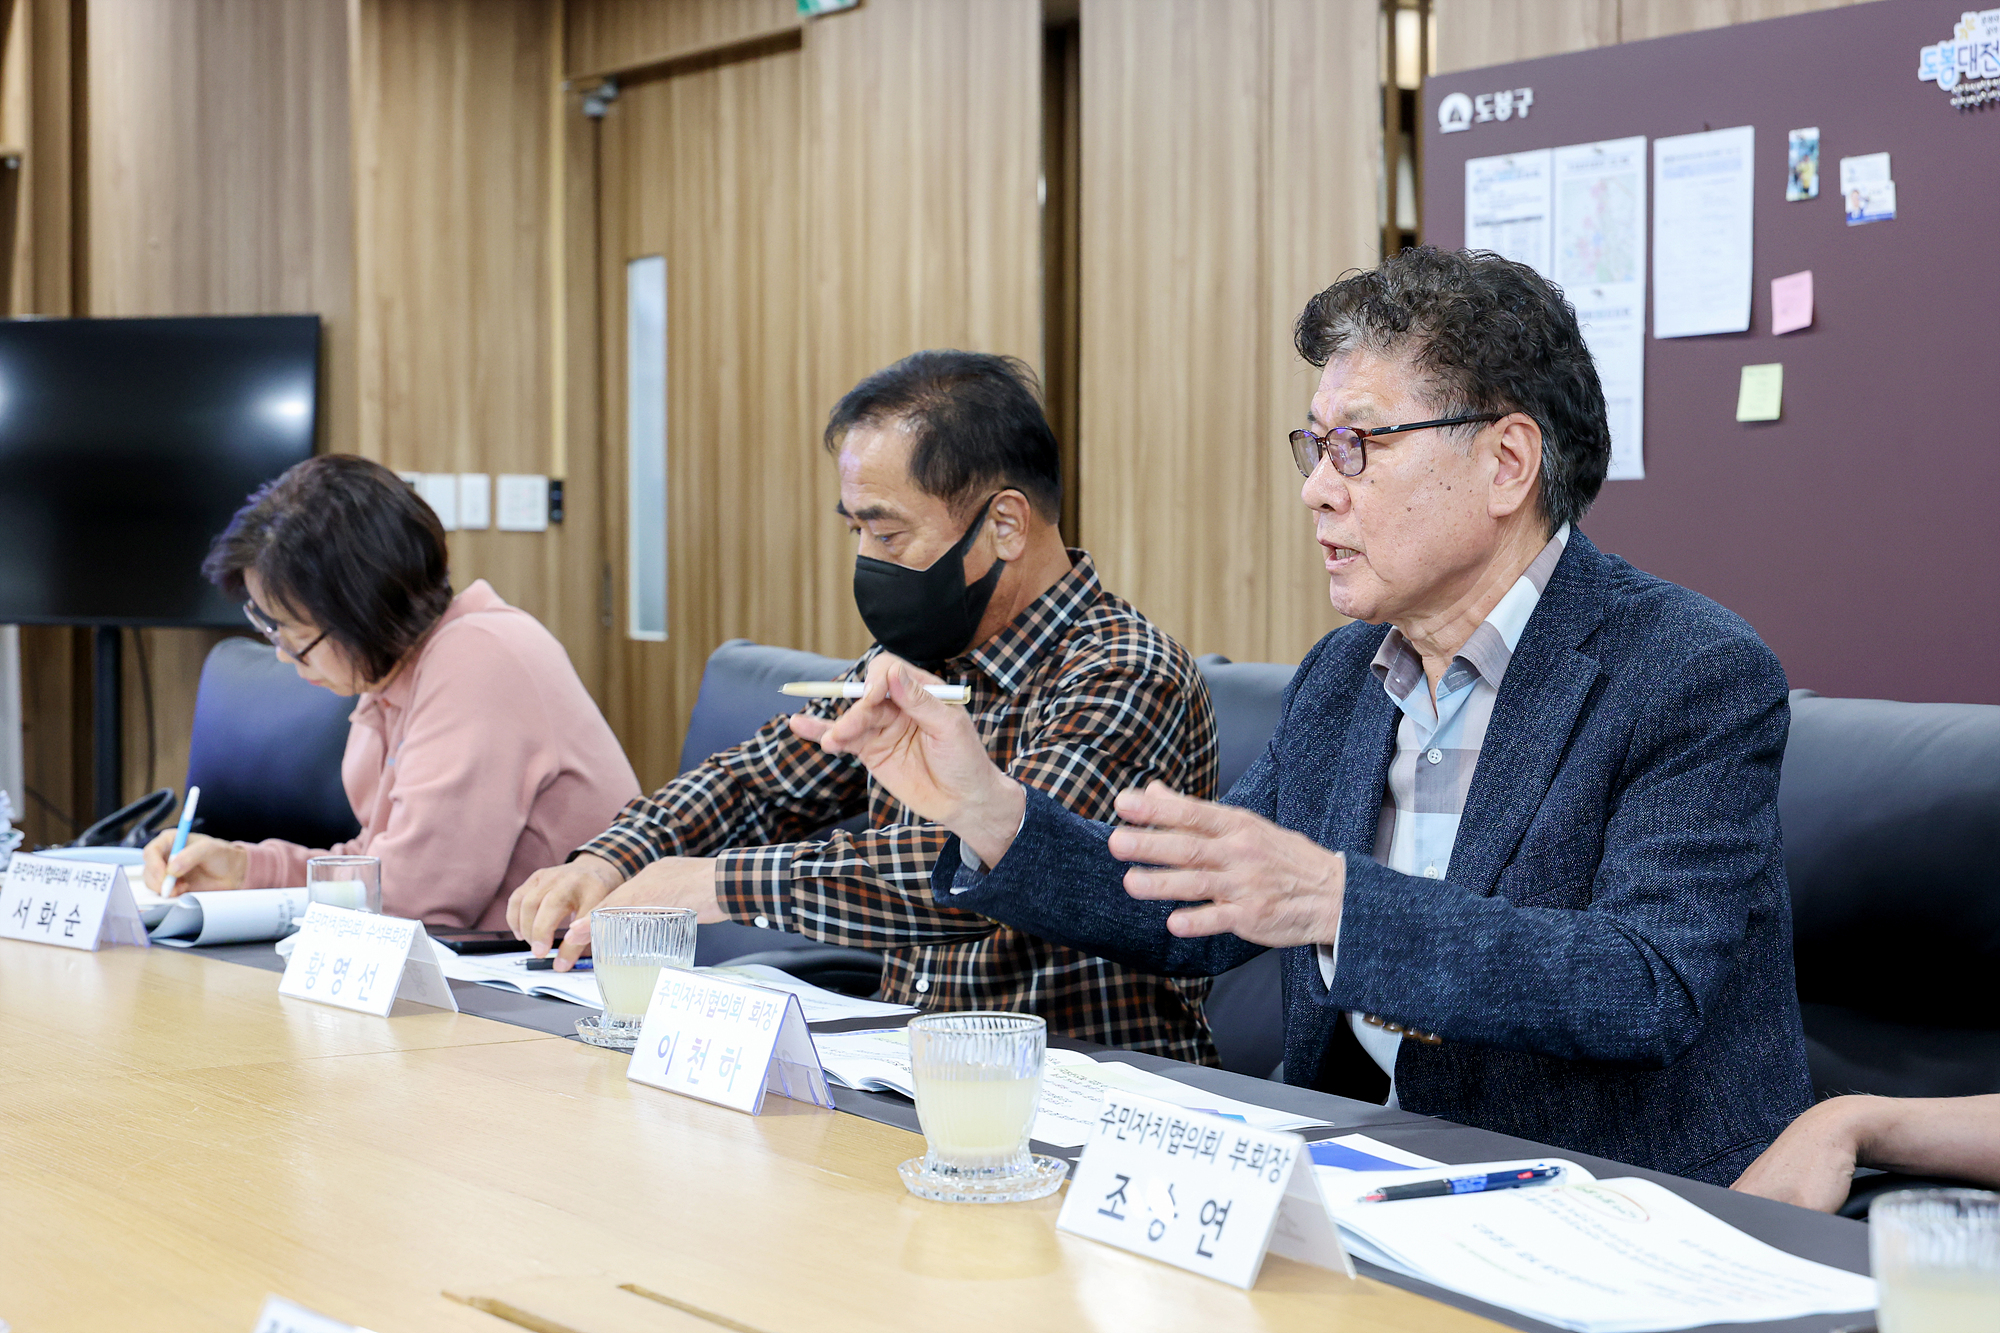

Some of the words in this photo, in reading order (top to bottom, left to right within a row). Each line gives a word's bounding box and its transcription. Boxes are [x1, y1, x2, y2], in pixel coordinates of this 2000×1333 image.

[1474, 87, 1533, 123] 도봉구
[305, 911, 366, 939] 주민자치협의회
[658, 979, 746, 1023] 주민자치협의회
[747, 1000, 778, 1031] 회장
[1100, 1103, 1225, 1164] 주민자치협의회
[1229, 1136, 1291, 1183] 부회장
